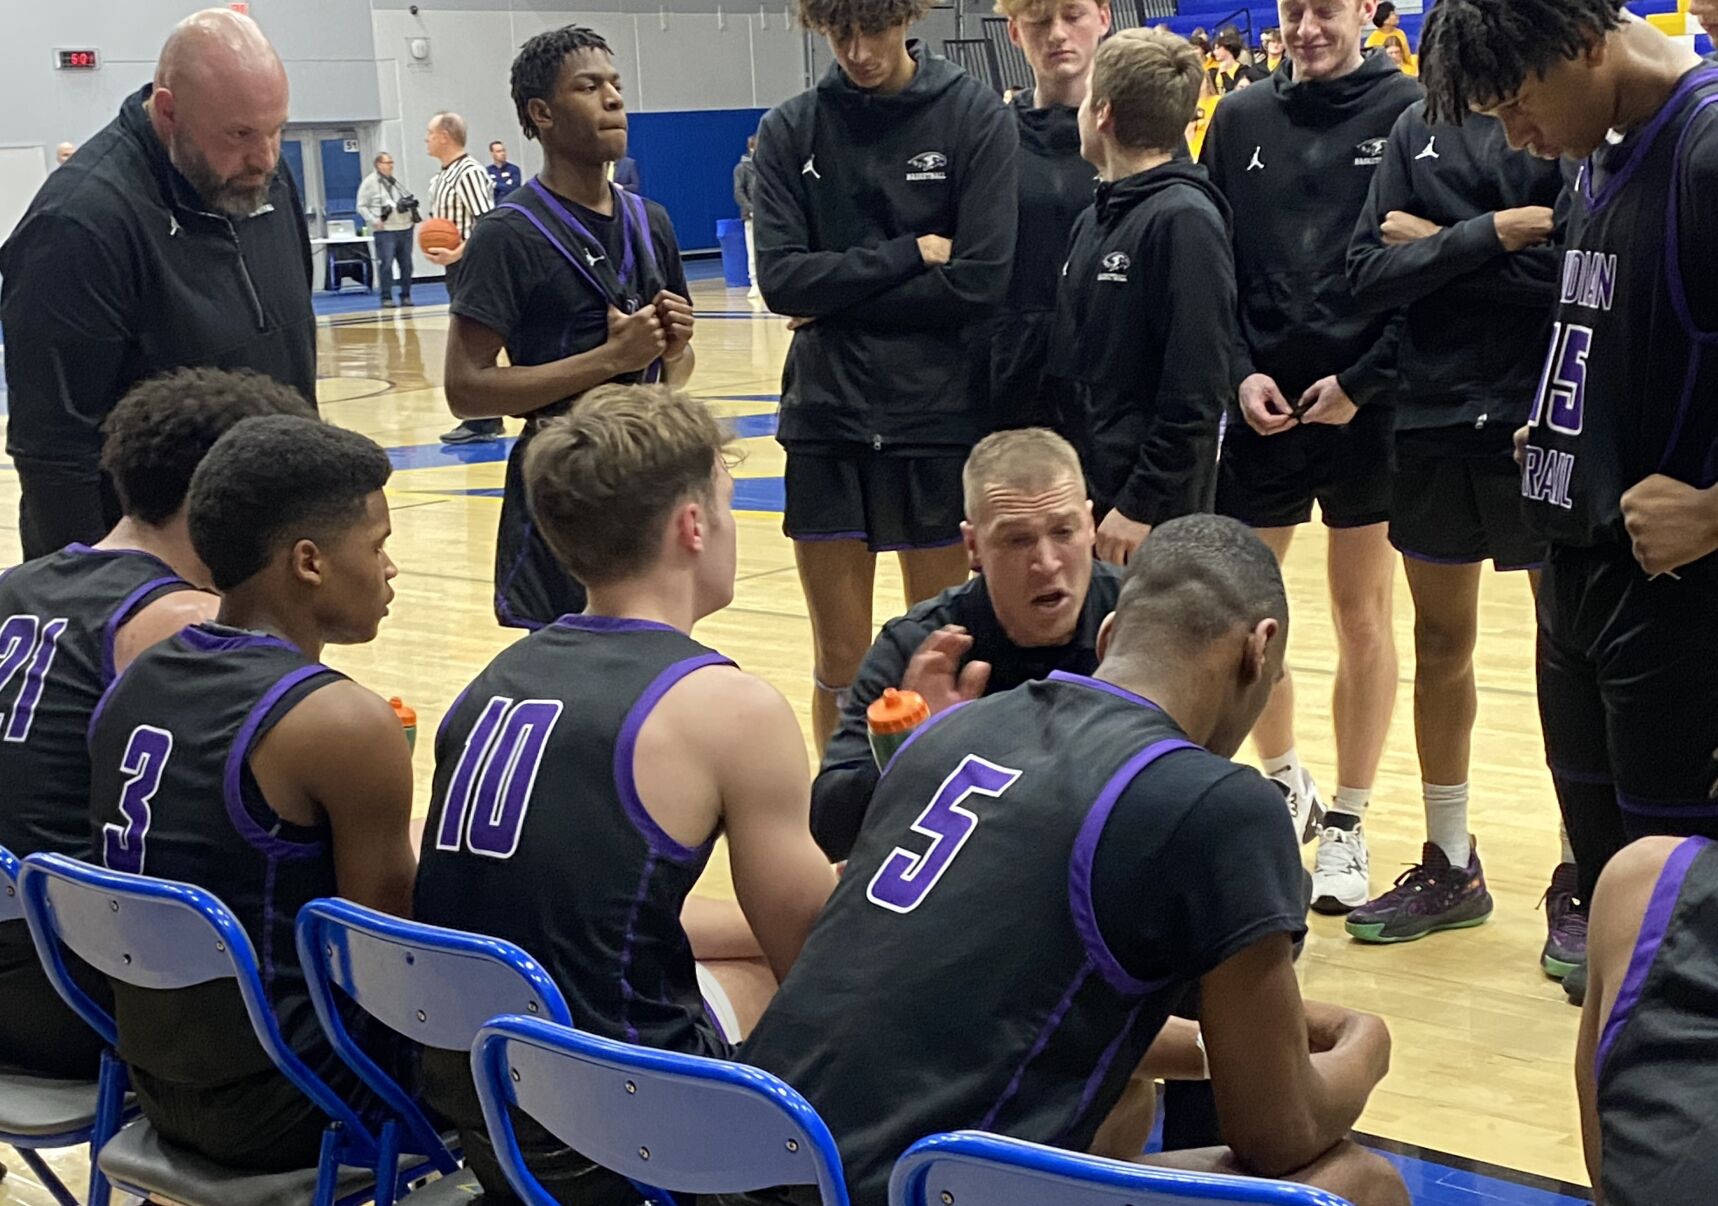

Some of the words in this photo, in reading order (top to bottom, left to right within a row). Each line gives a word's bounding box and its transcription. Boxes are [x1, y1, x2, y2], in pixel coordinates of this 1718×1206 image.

[102, 724, 173, 875] 3
[436, 695, 564, 859] 10
[866, 753, 1023, 914] 5
